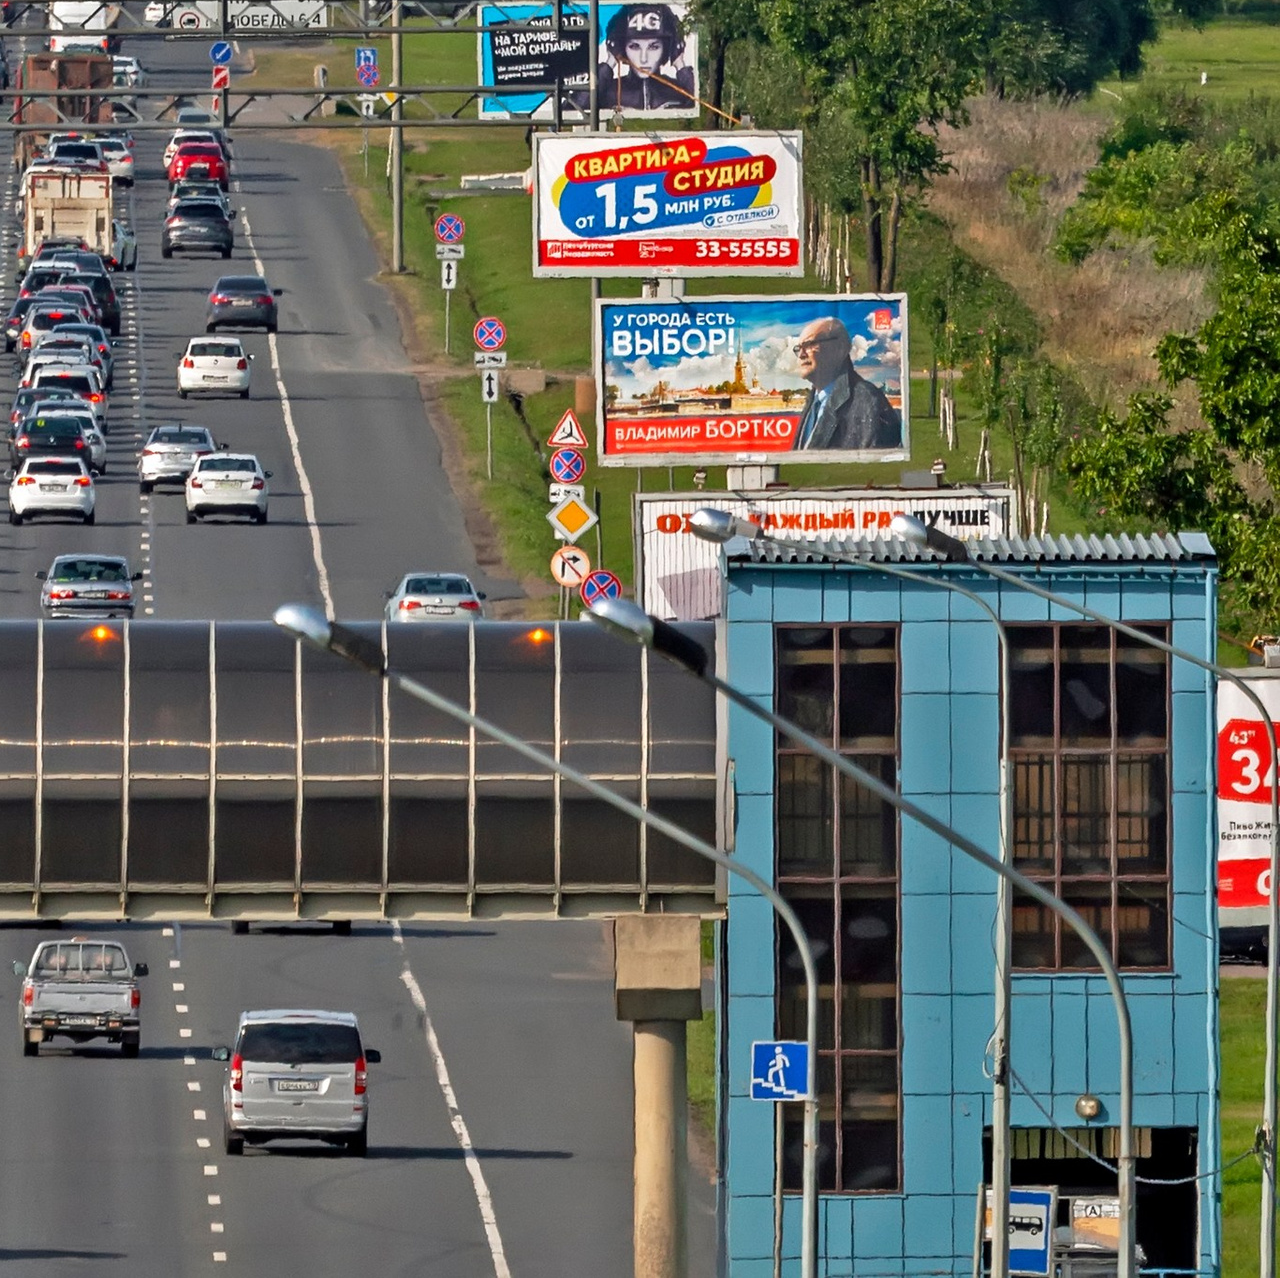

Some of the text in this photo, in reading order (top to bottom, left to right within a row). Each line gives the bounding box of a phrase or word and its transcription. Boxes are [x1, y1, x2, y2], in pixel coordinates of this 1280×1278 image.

[628, 12, 661, 31] 4G
[495, 31, 558, 47] НА ТАРИФЕ
[574, 144, 701, 178] КВАРТИРА-
[673, 160, 765, 191] СТУДИЯ
[595, 182, 658, 230] 1,5
[664, 198, 699, 216] МЛН
[725, 207, 775, 223] ОТДЕЛКОЙ
[695, 240, 792, 258] 33-55555
[613, 312, 735, 327] У ГОРОДА ЕСТЬ
[612, 328, 735, 356] ВЫБОР!
[615, 418, 792, 441] ВЛАДИМИР БОРТКО
[1230, 821, 1253, 830] Пиво
[1088, 1206, 1097, 1217] А
